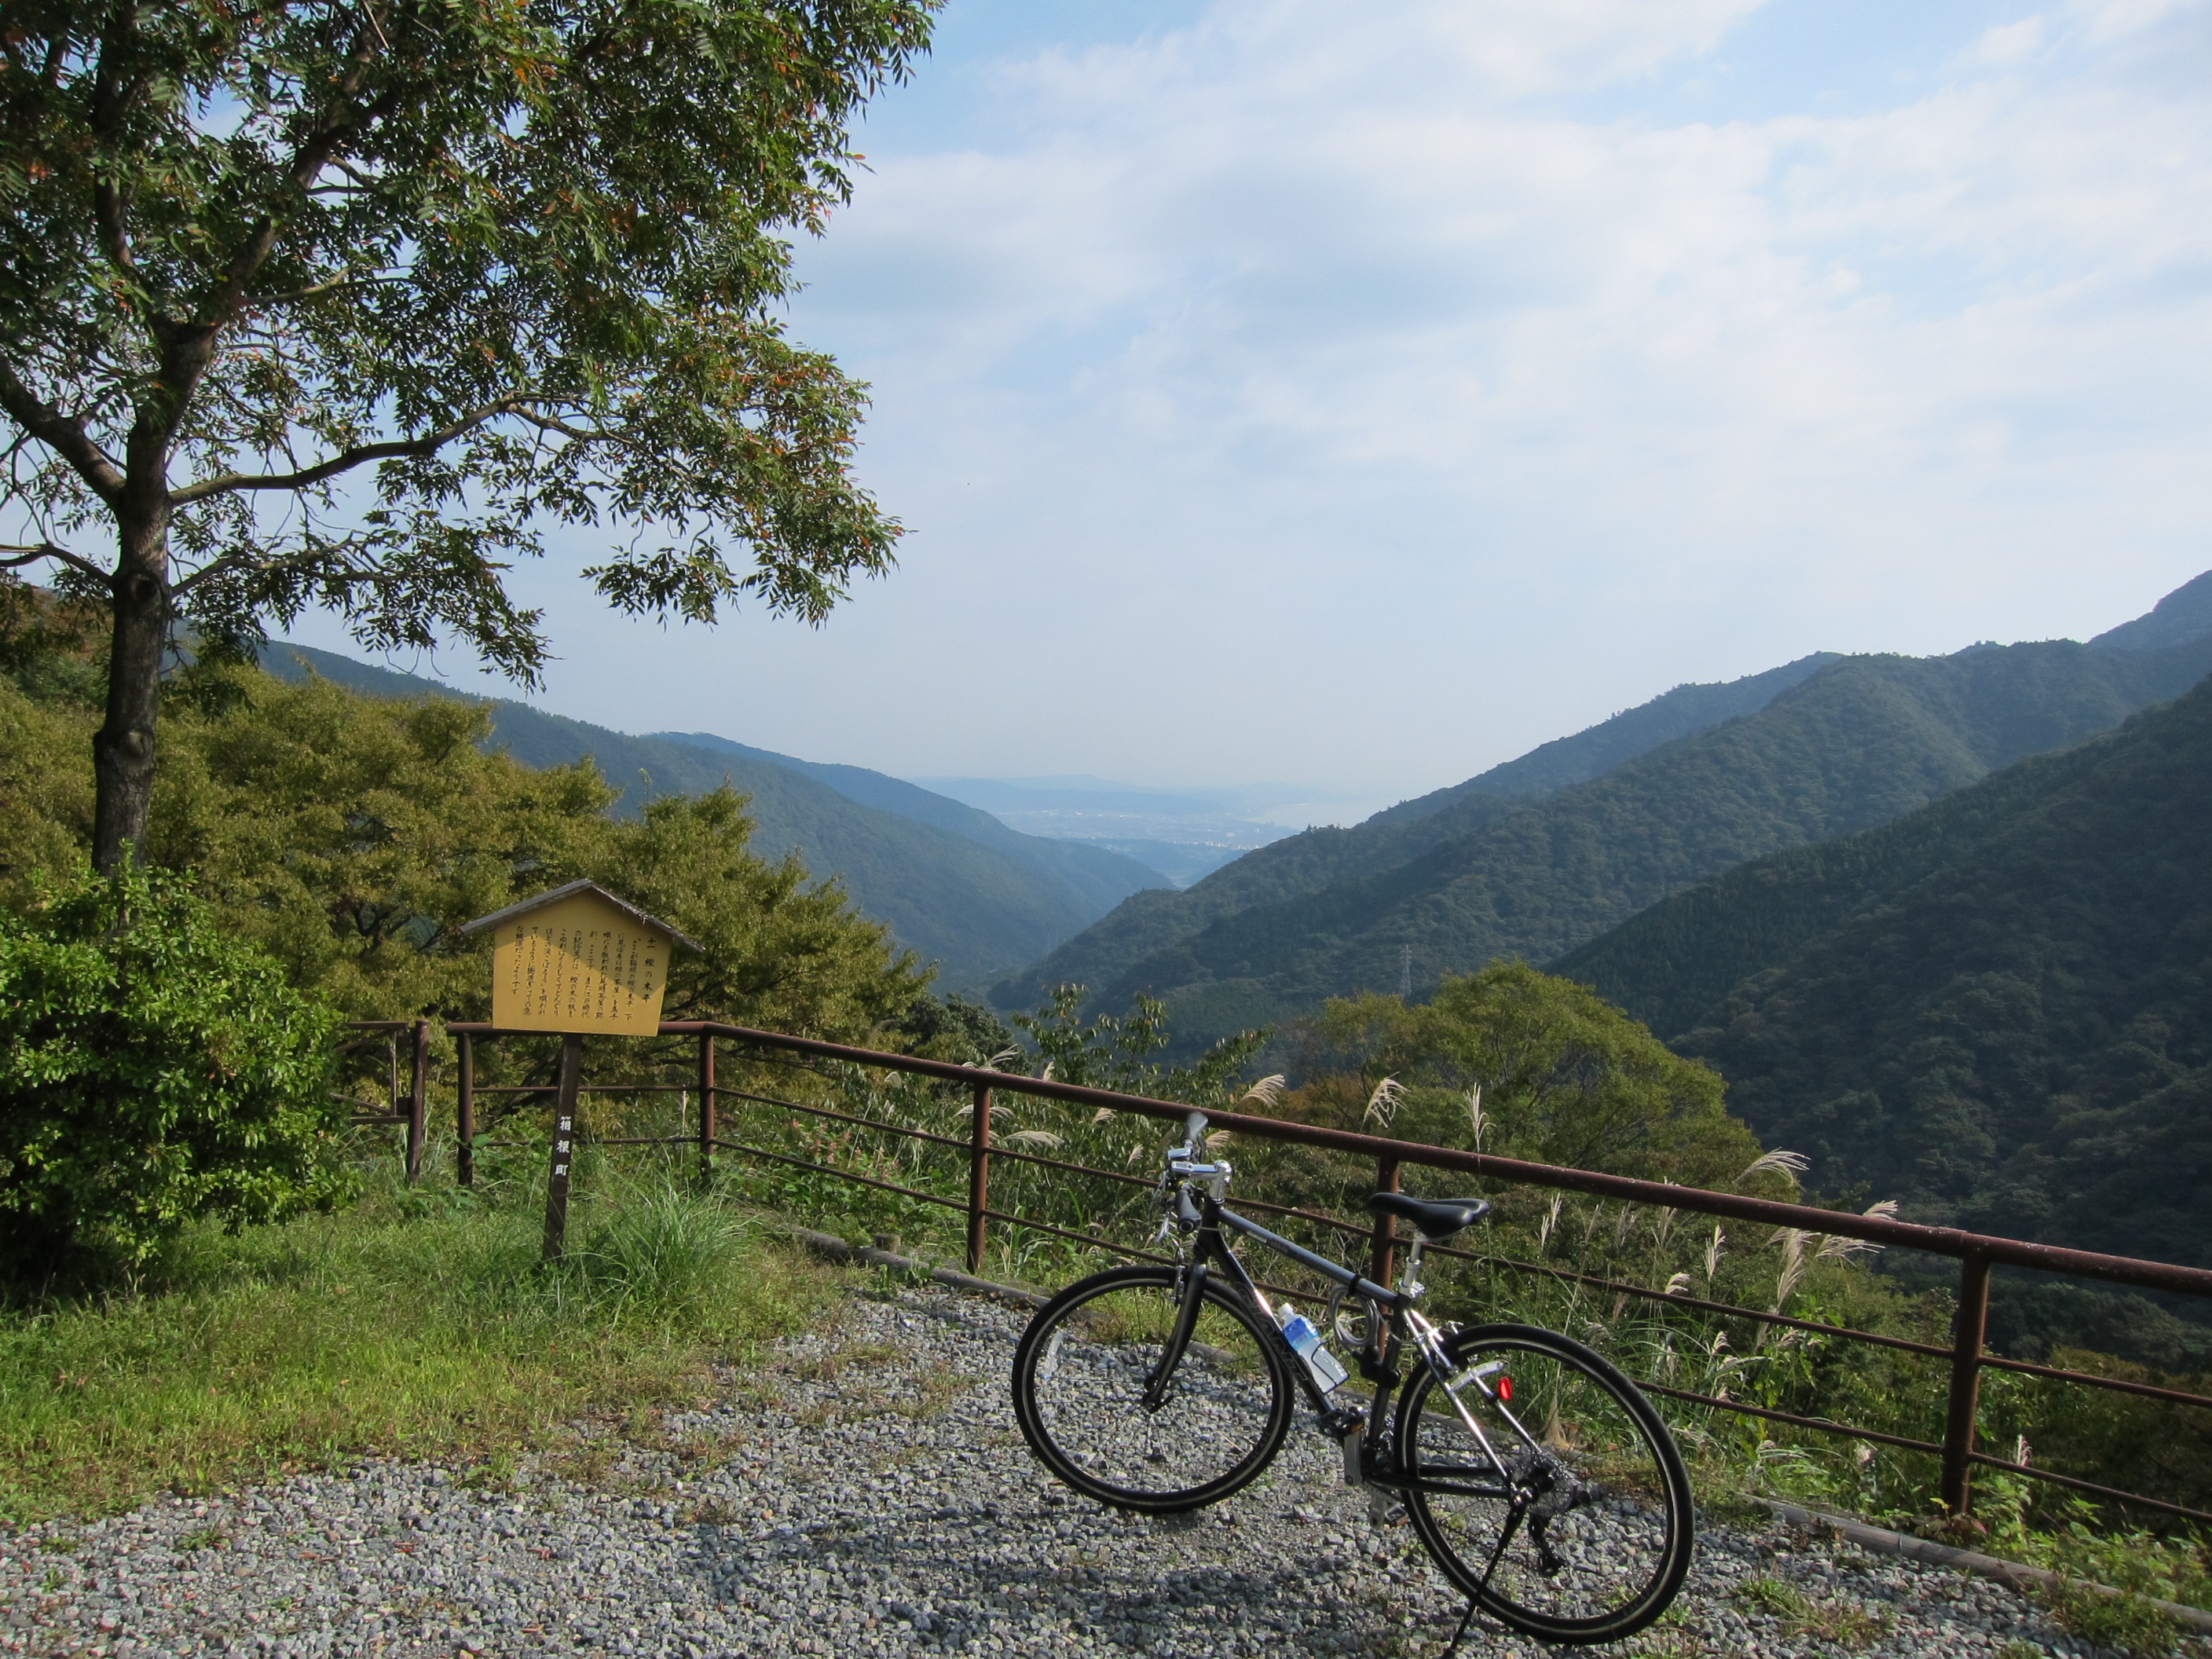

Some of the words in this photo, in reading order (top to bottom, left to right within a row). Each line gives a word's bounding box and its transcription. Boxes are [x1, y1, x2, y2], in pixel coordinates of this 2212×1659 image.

[555, 1115, 572, 1177] 箱根町
[1233, 1281, 1308, 1382] GIANT
